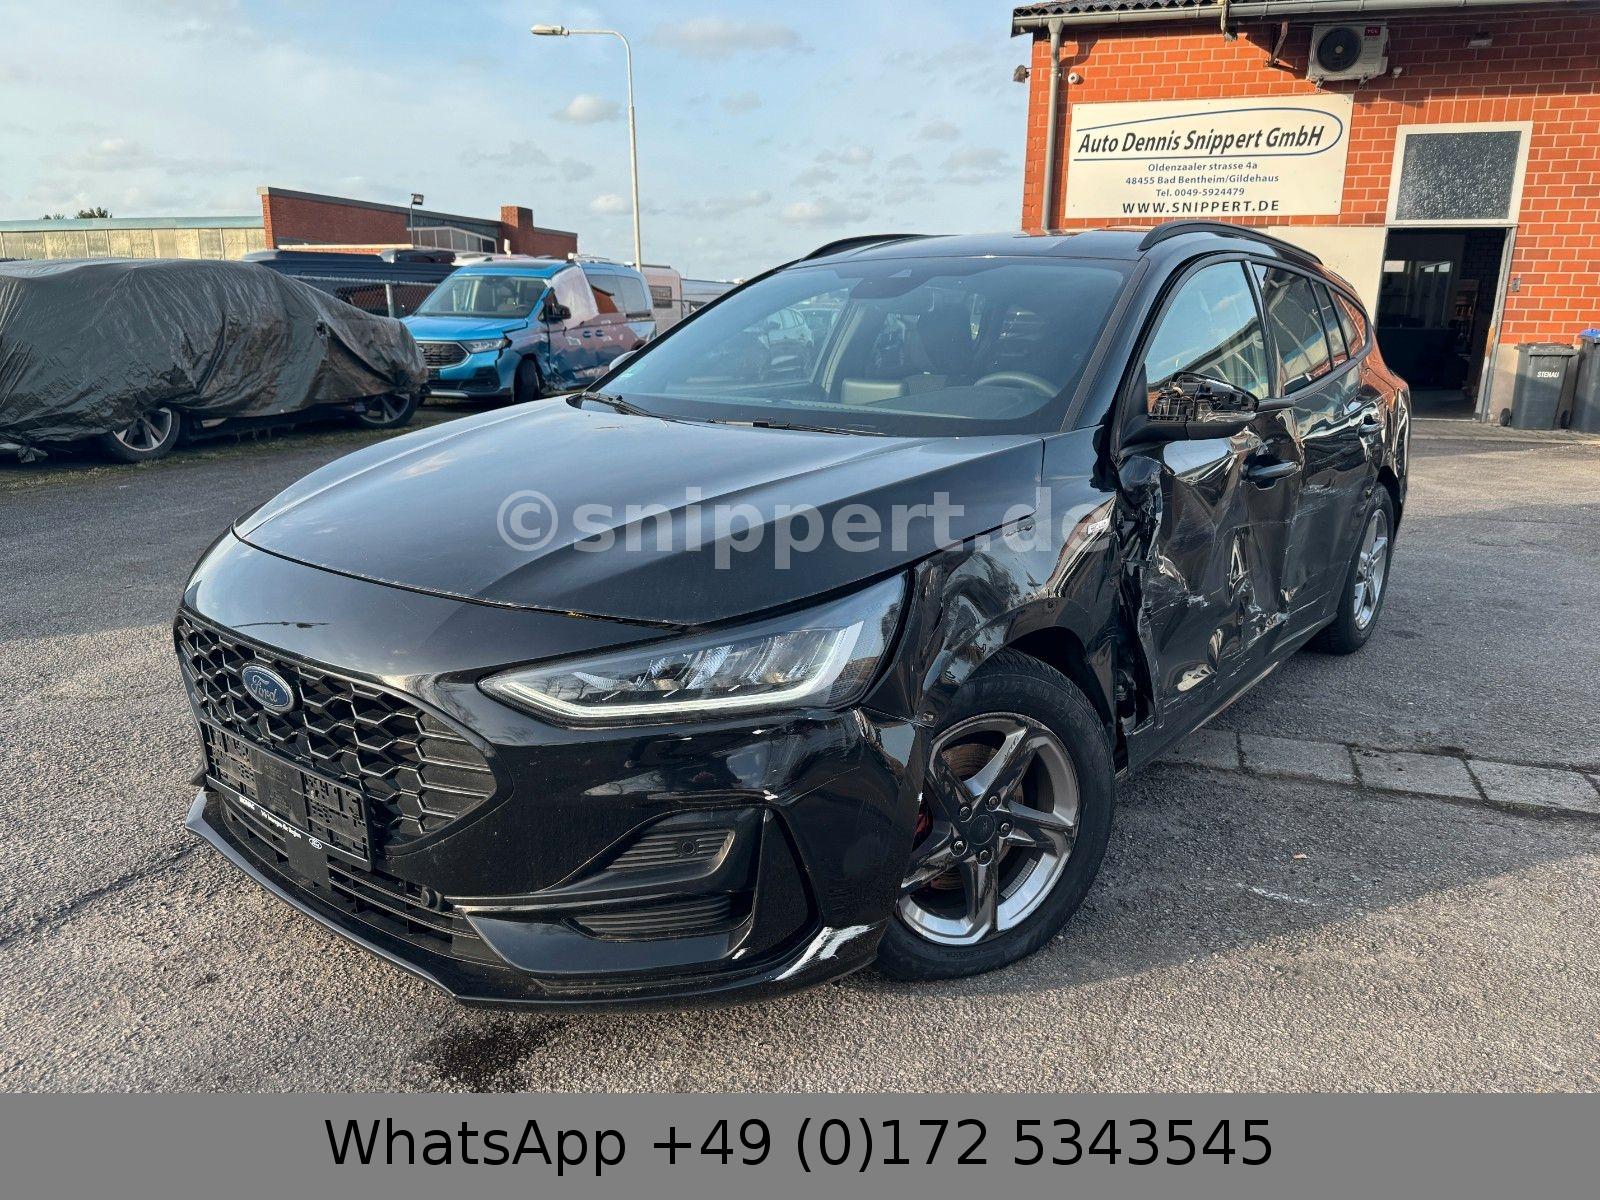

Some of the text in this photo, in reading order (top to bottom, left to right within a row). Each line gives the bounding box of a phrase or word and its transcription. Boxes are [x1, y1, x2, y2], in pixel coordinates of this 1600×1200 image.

[1078, 125, 1325, 155] Auto Dennis Snippert GmbH
[1148, 161, 1258, 172] Oldenzaaler strasse 4a
[1125, 173, 1279, 185] 48455 Bad Bentheim/Gildehaus
[1155, 187, 1245, 197] Tel. 0049-5924479
[1122, 200, 1279, 213] WWW.SNIPPERT.DE
[1537, 371, 1560, 379] STENAU
[250, 674, 278, 703] Ford
